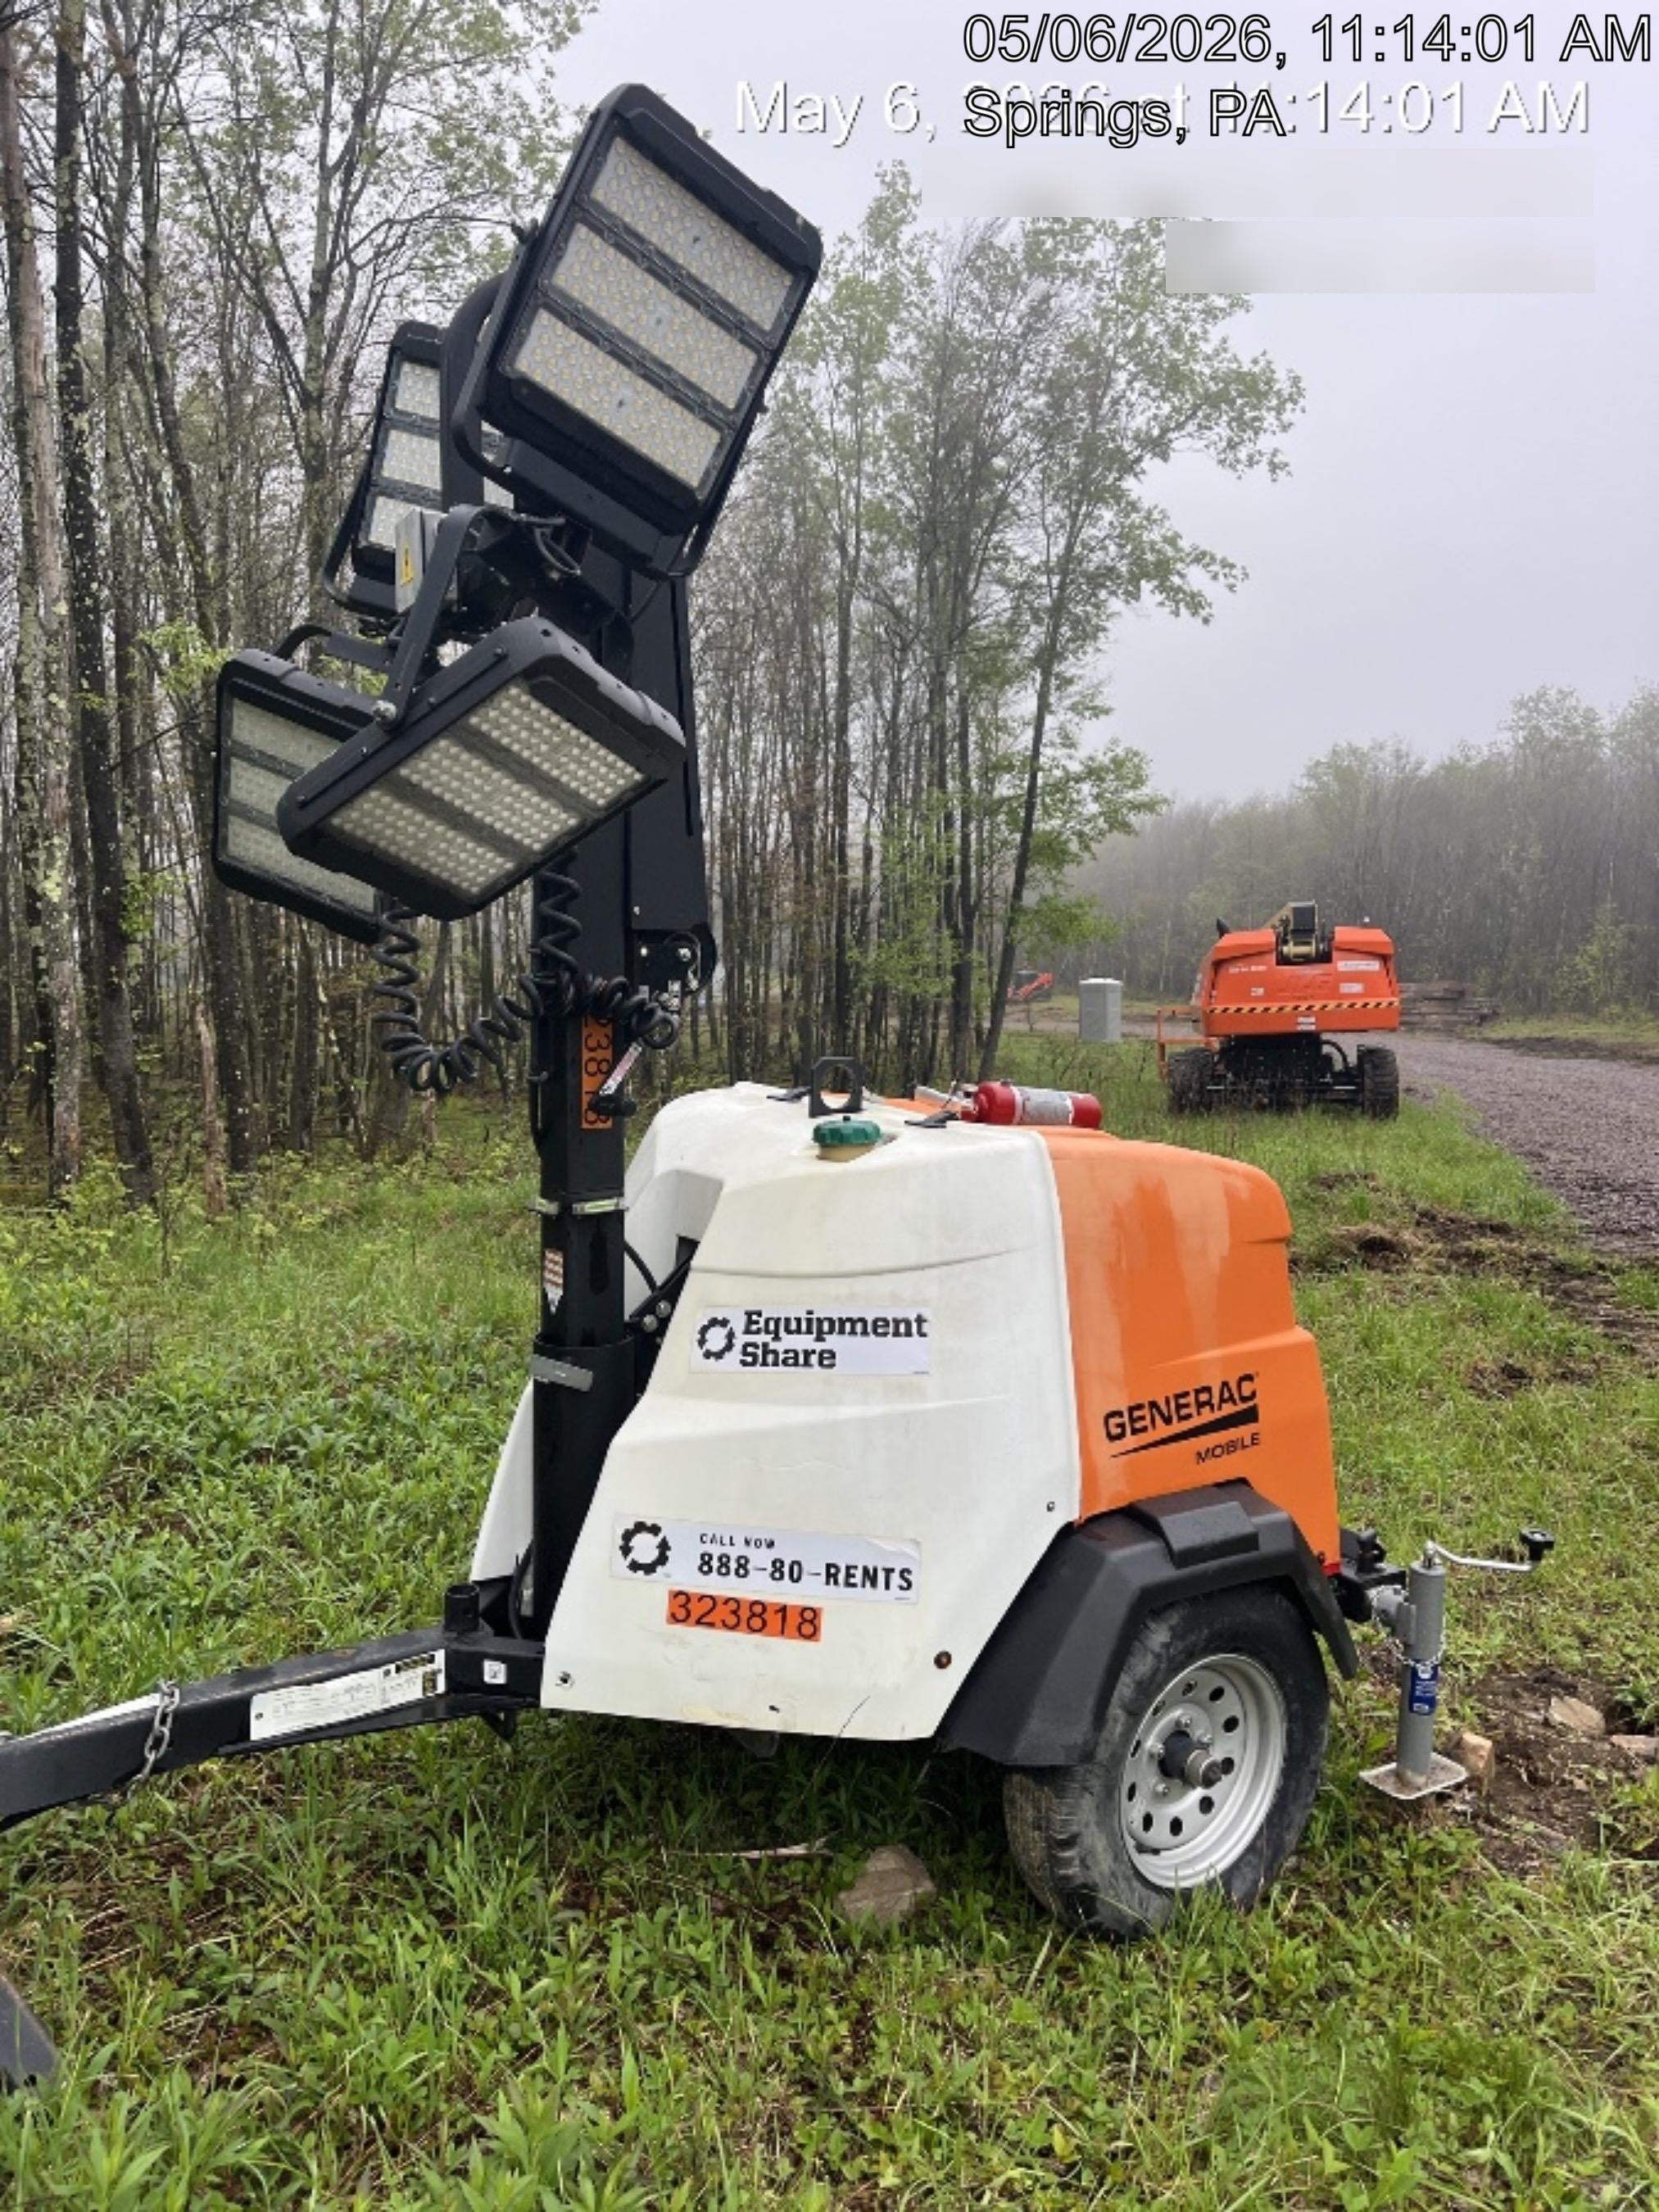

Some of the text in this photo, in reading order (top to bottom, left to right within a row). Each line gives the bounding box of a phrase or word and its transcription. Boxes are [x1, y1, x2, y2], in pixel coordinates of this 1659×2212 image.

[741, 1309, 930, 1342] Equipment
[739, 1341, 837, 1369] Share
[1103, 1373, 1258, 1443] GENERAC
[1195, 1432, 1261, 1465] MOBILE
[699, 1532, 776, 1550] CALL NOW
[697, 1552, 913, 1592] 888-80-RENTS
[669, 1590, 819, 1639] 323818
